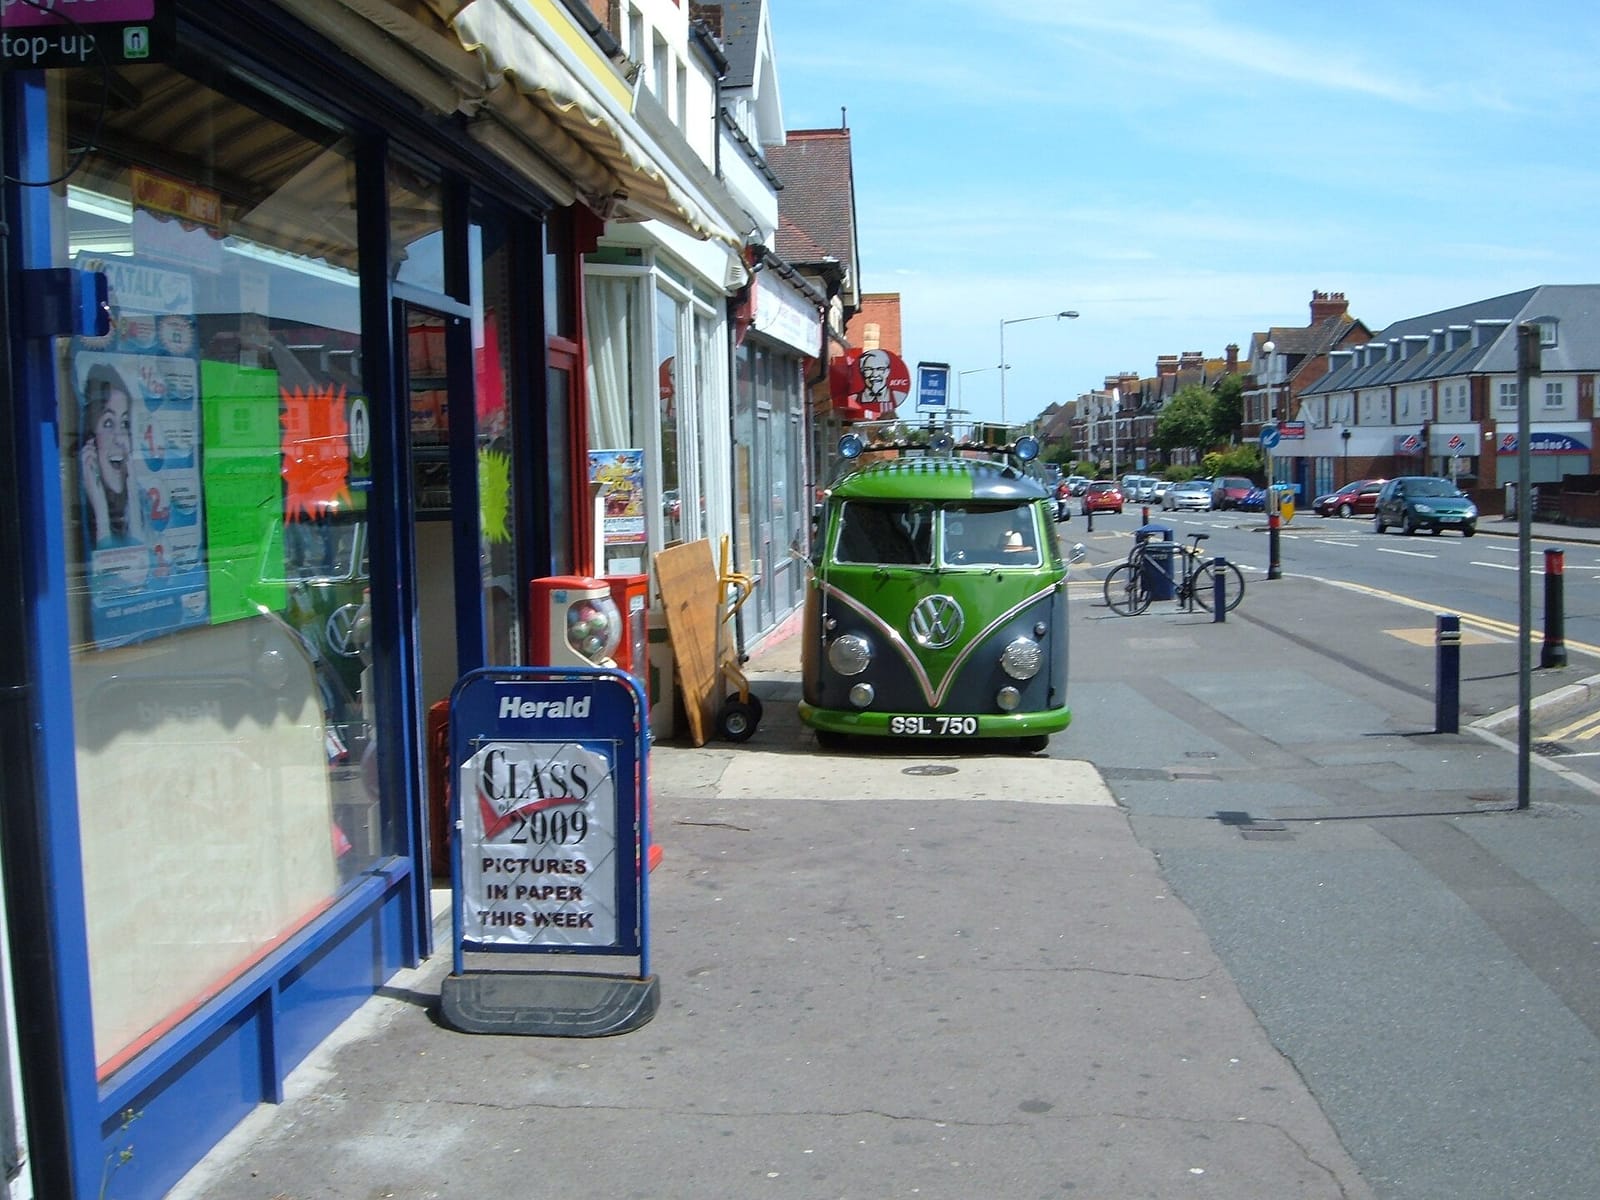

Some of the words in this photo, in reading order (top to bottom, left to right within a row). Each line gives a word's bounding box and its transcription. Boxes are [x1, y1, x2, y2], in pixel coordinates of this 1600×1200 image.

[1, 33, 96, 64] top-up
[1529, 438, 1572, 450] omino's
[498, 695, 592, 719] Herald
[891, 716, 932, 735] SSL
[935, 716, 977, 735] 750
[511, 810, 588, 845] 2009
[482, 857, 587, 875] PICTURES
[487, 884, 508, 900] IN
[515, 884, 582, 901] PAPER
[477, 910, 526, 927] THIS
[533, 911, 594, 929] WEEK
